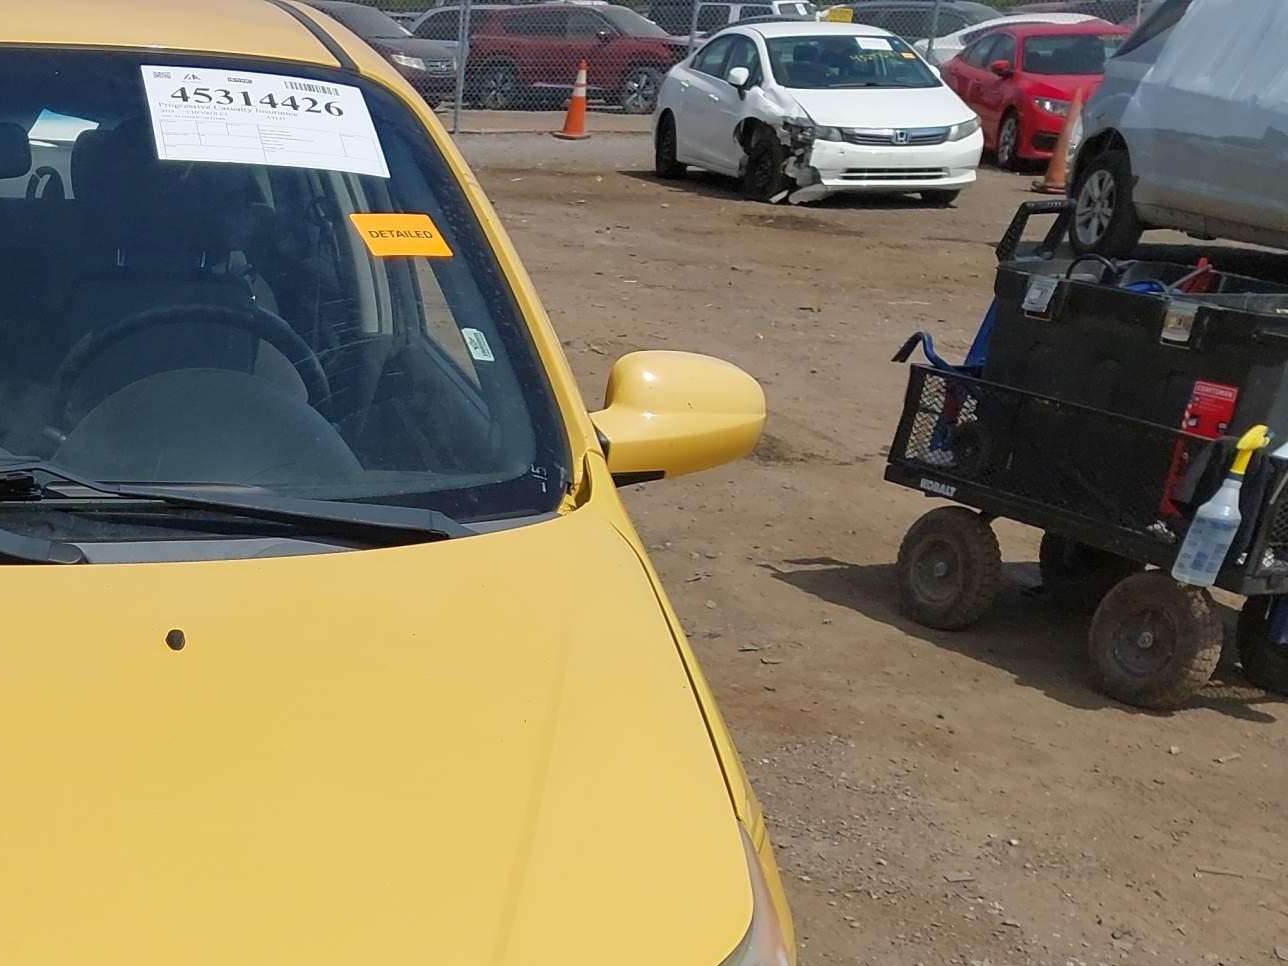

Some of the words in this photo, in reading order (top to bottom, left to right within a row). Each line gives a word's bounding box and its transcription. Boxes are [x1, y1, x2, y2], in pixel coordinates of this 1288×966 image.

[170, 86, 344, 117] 45314426
[158, 102, 211, 111] Progressive
[213, 104, 252, 113] Casualty
[255, 107, 299, 117] Insurance
[368, 230, 433, 239] DETAILED
